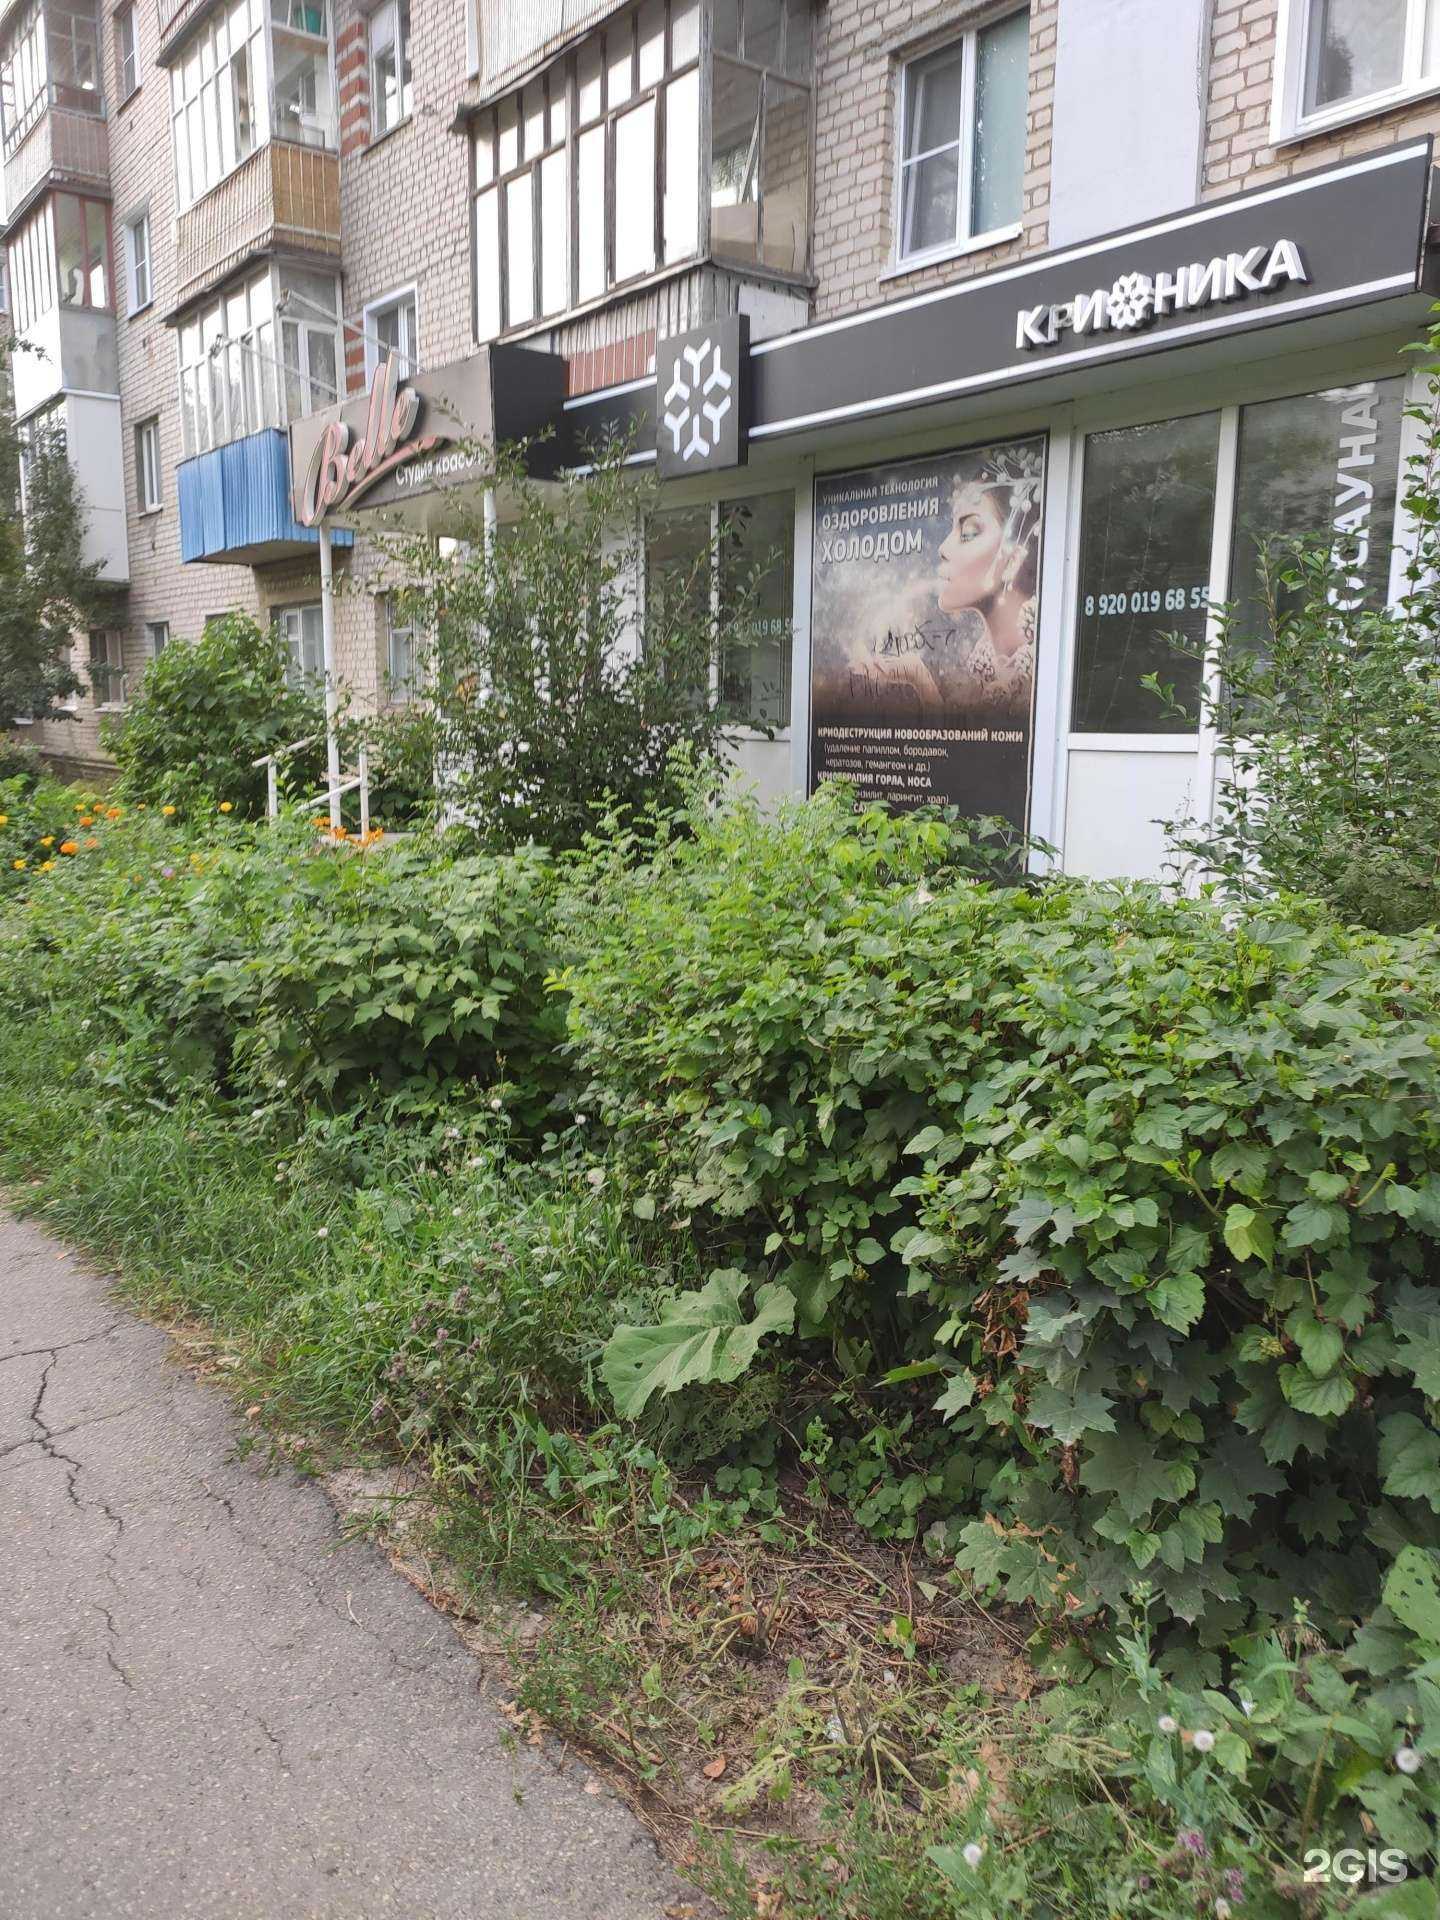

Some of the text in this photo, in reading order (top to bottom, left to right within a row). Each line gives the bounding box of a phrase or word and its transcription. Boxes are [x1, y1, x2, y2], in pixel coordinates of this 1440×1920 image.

[302, 350, 420, 527] Belle
[823, 476, 938, 505] УНИКАЛЬНАЯ ТЕХНОЛОГИЯ
[822, 497, 939, 532] ОЗДОРОВЛЕНИЯ
[822, 527, 923, 563] ХОЛОДОМ
[1085, 595, 1095, 616] 8
[1099, 592, 1127, 615] 920
[1130, 590, 1161, 613] 019
[1164, 588, 1186, 611] 68
[817, 726, 1024, 743] КРИОДЕСТРУКЦИЯ НОВООБРАЗОВАНИЙ КОЖИ
[907, 763, 914, 771] и
[875, 775, 905, 789] ГОРЛА,
[907, 777, 932, 788] НОСА
